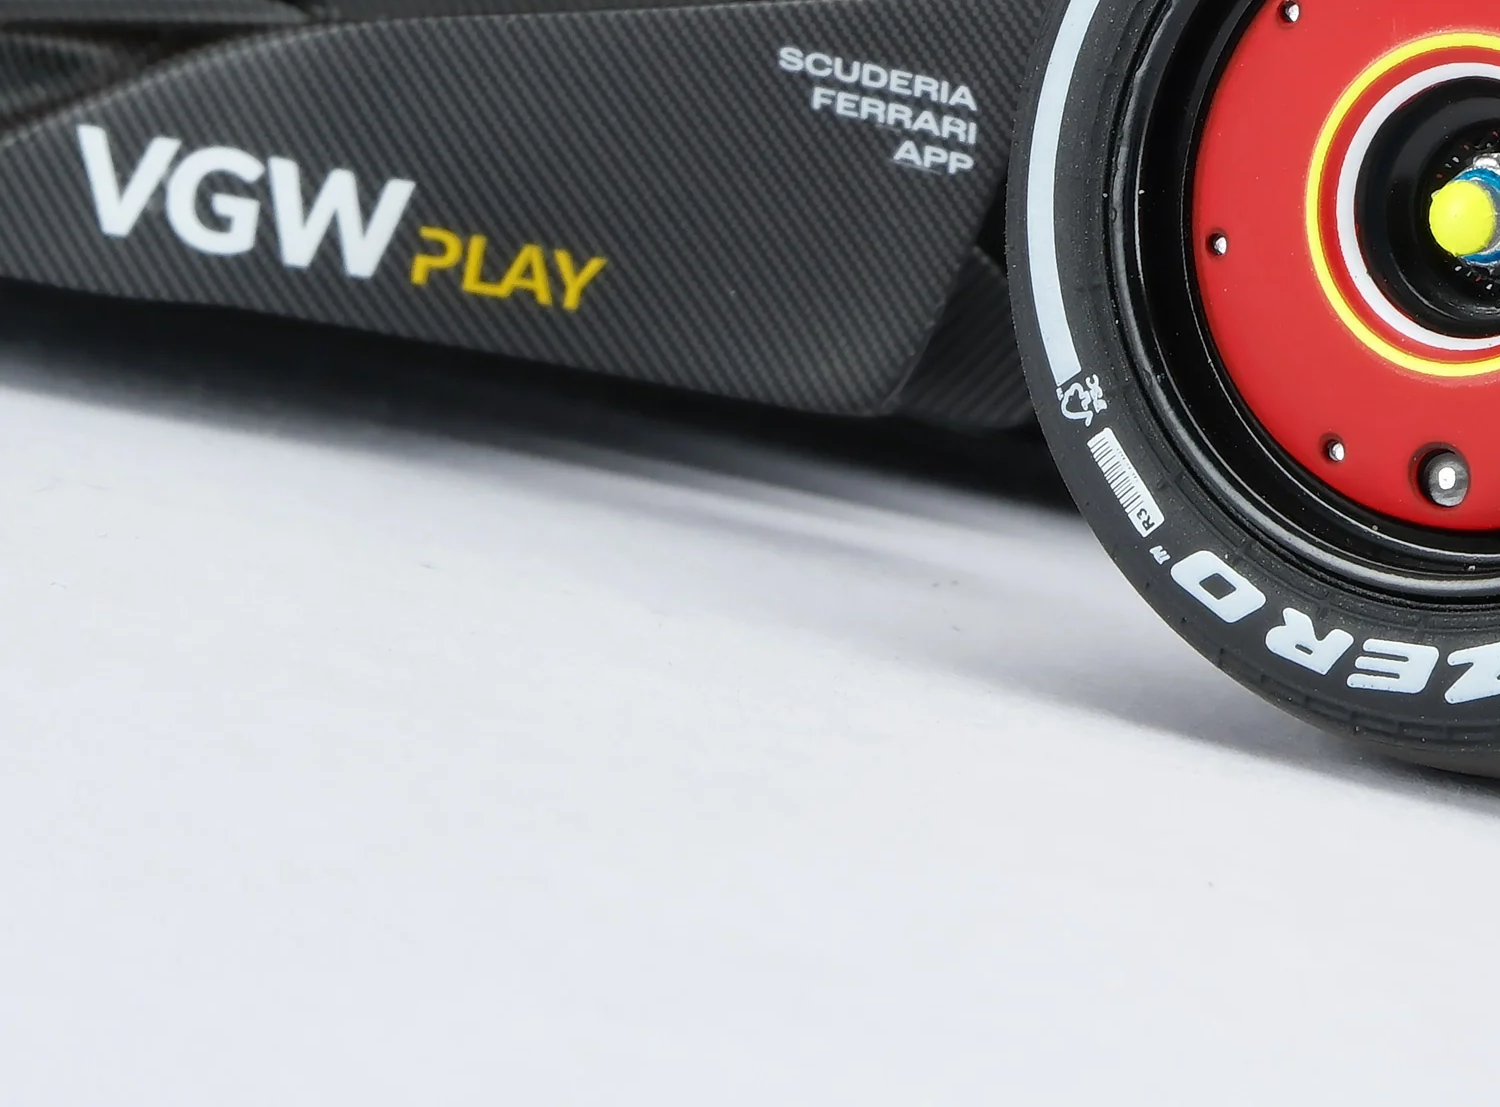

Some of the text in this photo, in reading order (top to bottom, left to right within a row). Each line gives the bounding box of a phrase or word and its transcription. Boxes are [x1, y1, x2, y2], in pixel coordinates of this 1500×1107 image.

[779, 47, 977, 111] SCUDERIA
[811, 86, 977, 145] FERRARI
[893, 140, 974, 174] APP
[77, 124, 607, 321] VGW PLAY
[1136, 508, 1155, 532] R3
